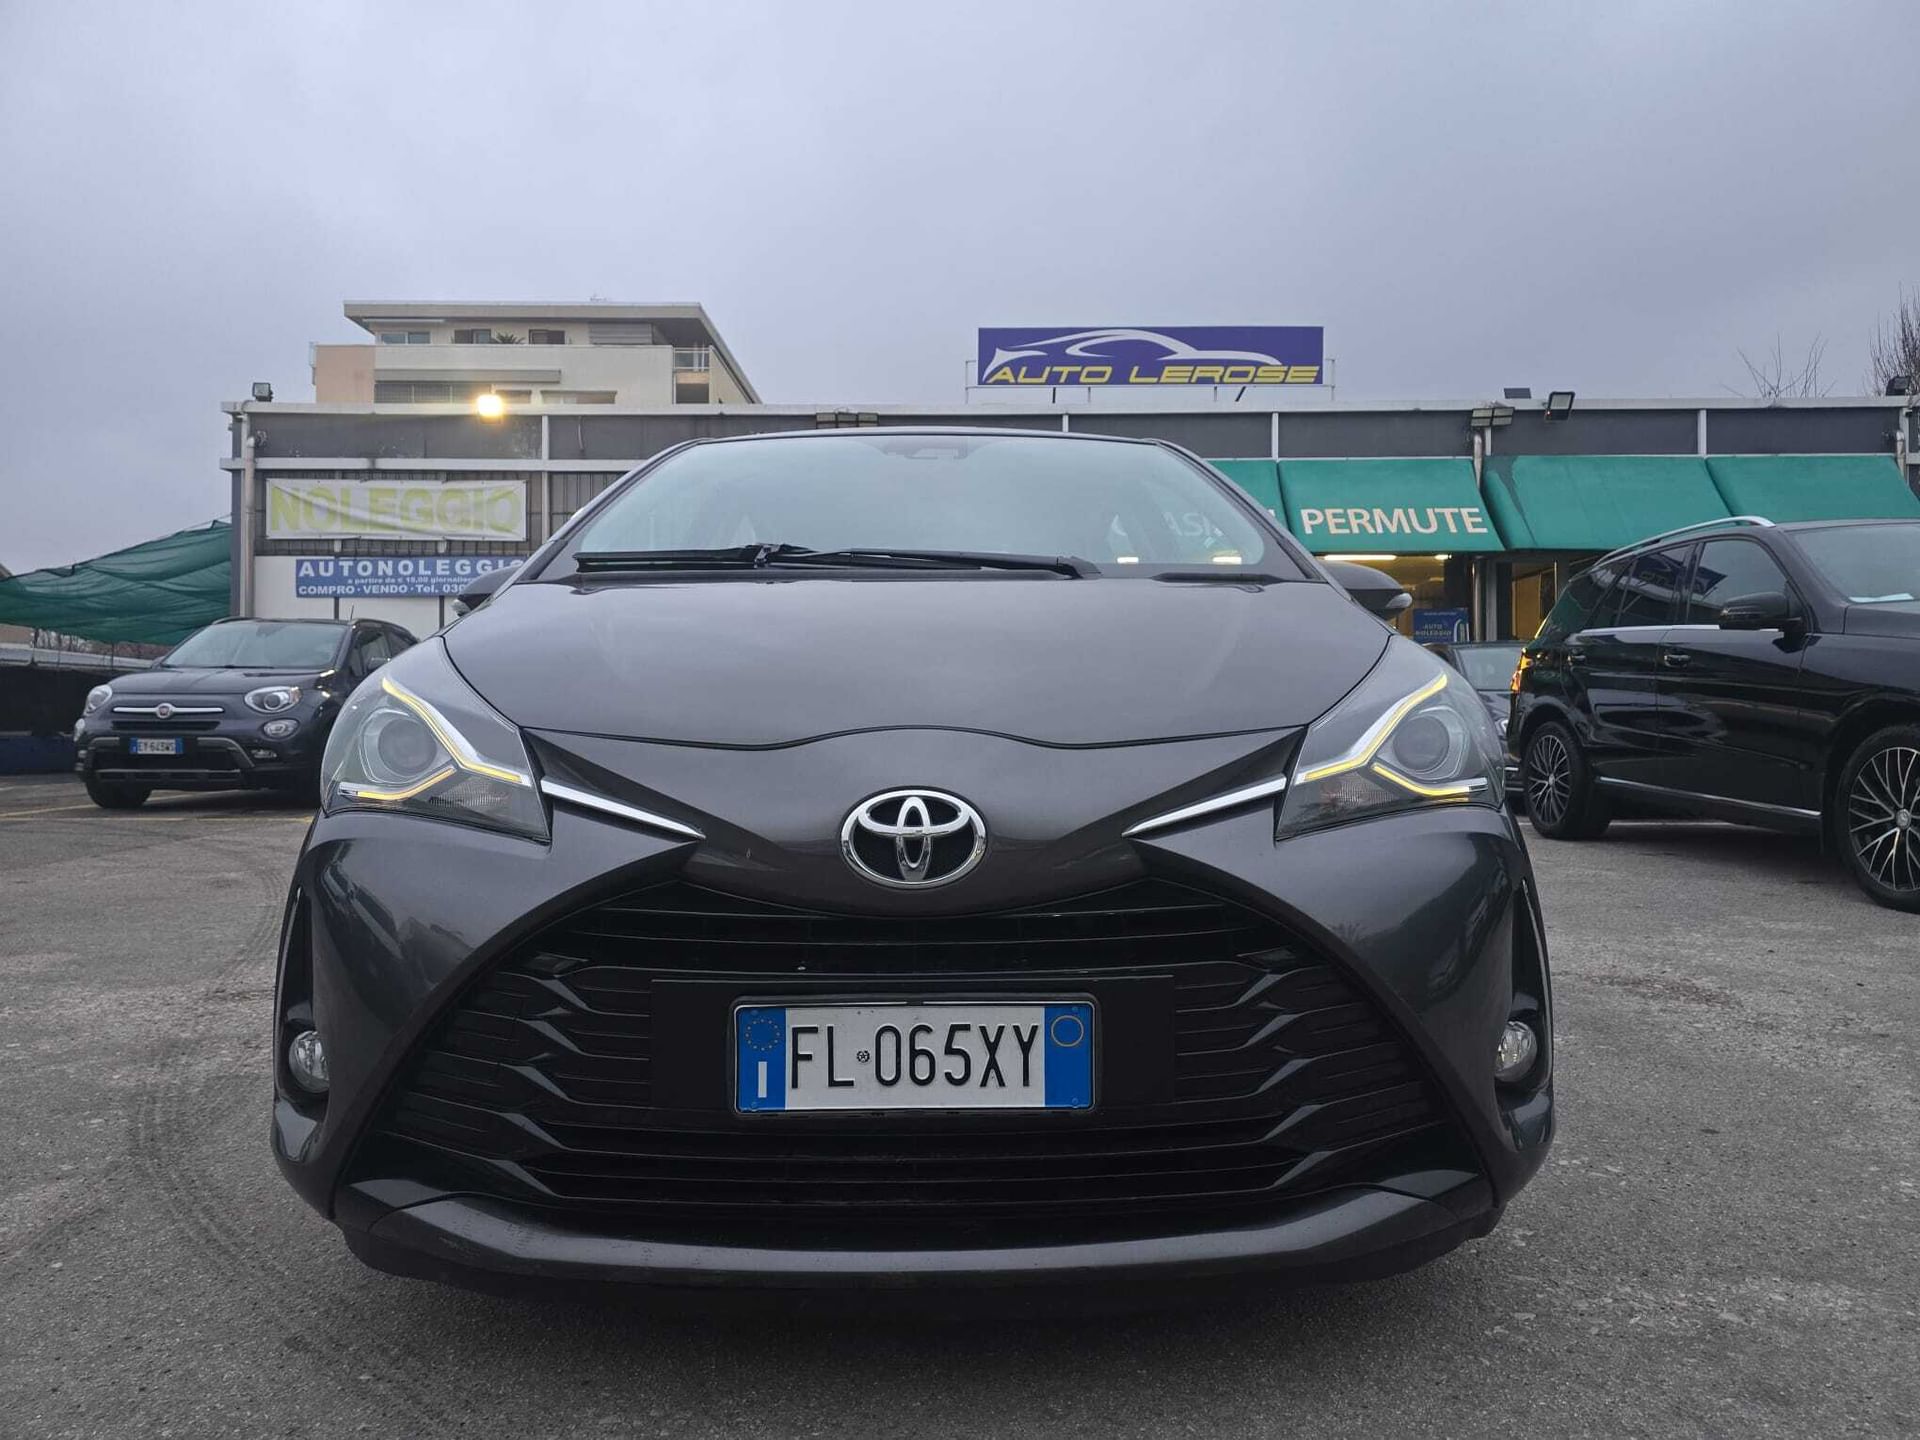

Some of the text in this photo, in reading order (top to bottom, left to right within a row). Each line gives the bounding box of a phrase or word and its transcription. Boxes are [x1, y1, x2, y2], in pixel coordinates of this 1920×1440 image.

[987, 365, 1320, 384] AUTO LEROSE
[271, 486, 521, 532] NOLEGGIO
[1300, 507, 1488, 535] PERMUTE
[298, 585, 355, 595] COMPRO
[363, 584, 408, 594] VENDO
[416, 584, 439, 593] Tel.
